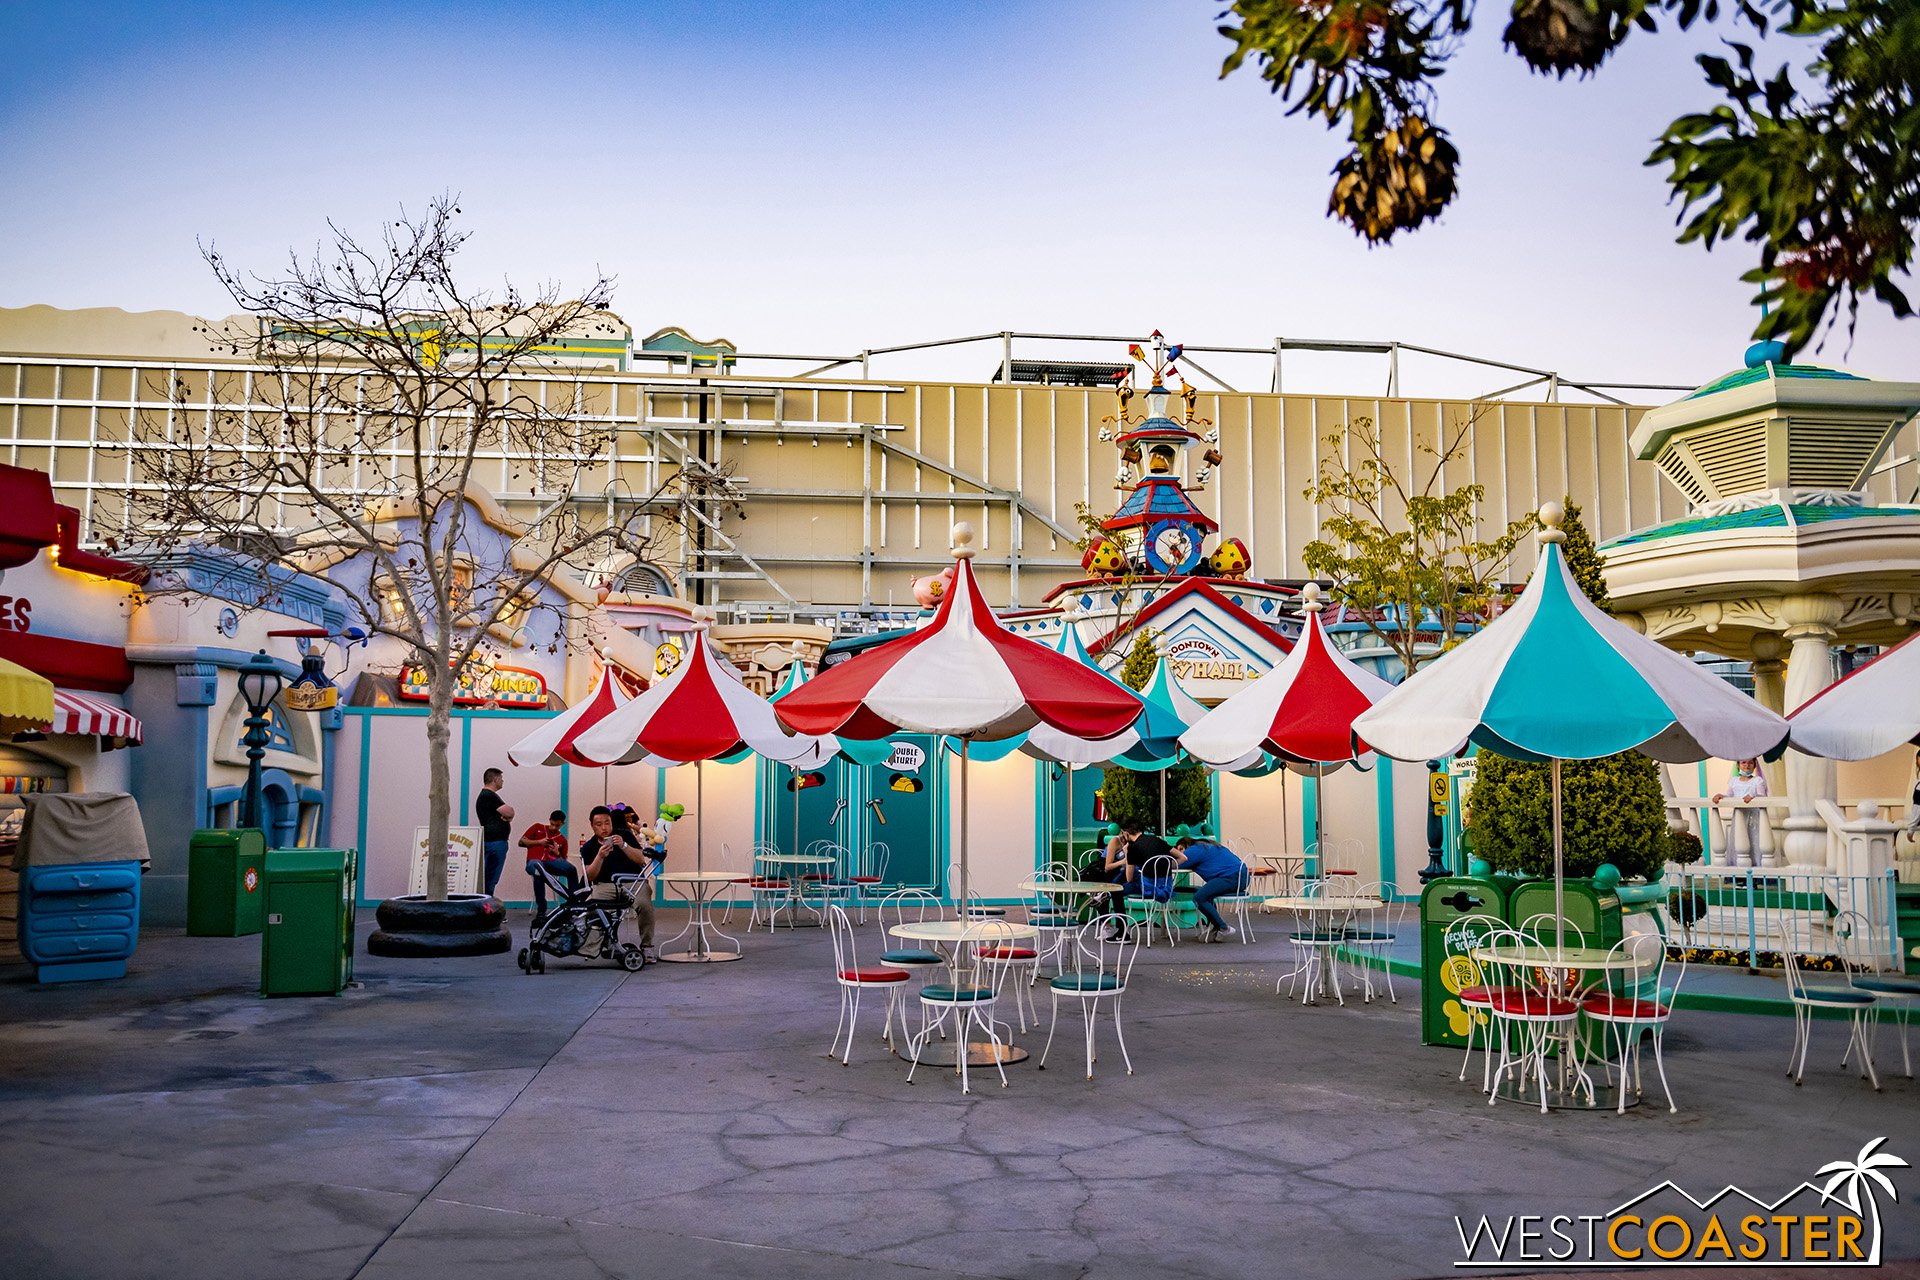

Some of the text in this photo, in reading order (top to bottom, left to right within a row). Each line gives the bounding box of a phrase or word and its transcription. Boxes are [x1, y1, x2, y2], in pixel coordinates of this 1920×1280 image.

[1193, 661, 1244, 680] HALL
[493, 677, 537, 694] DINER
[895, 748, 918, 756] OUBLE
